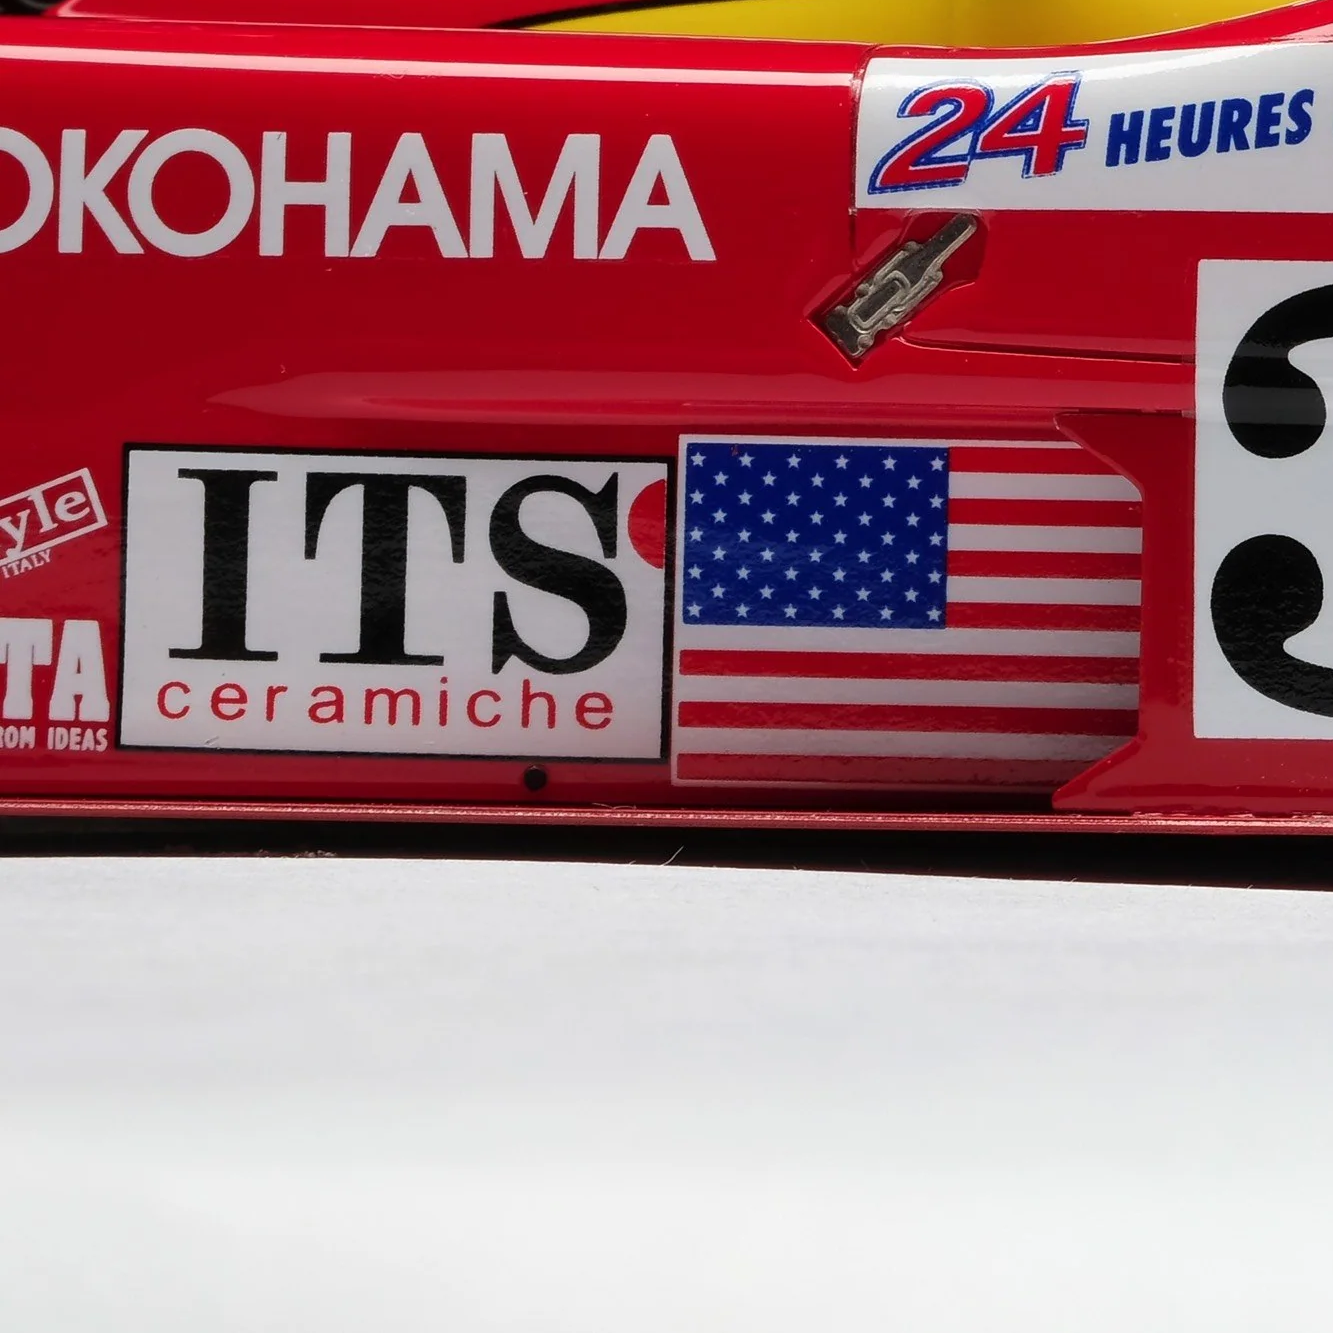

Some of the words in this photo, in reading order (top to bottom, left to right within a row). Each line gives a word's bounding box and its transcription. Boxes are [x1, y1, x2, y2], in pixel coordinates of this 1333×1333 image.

[868, 69, 1089, 195] 24
[1105, 87, 1316, 168] HEURES
[2, 548, 52, 578] ITALY
[168, 467, 628, 675] ITS
[156, 676, 615, 731] ceramiche
[47, 726, 108, 752] IDEAS
